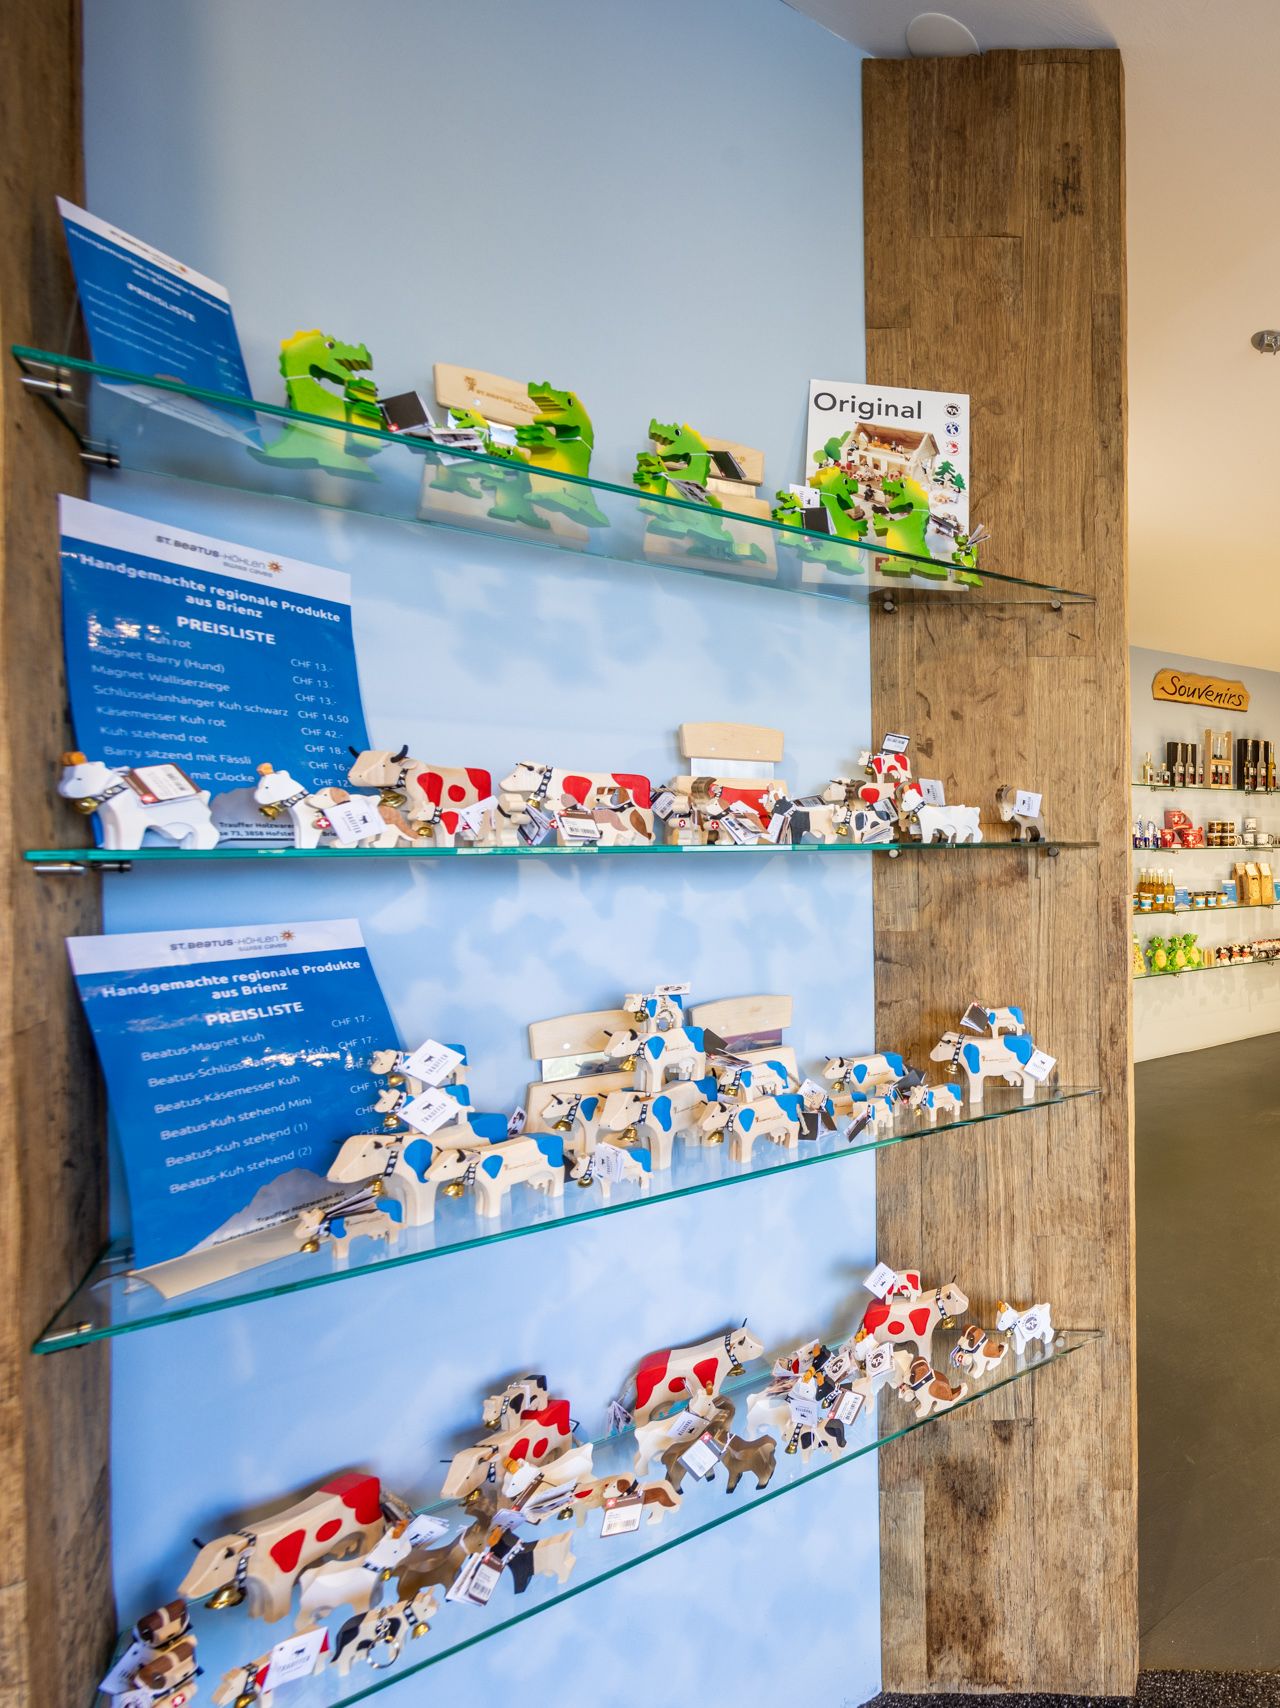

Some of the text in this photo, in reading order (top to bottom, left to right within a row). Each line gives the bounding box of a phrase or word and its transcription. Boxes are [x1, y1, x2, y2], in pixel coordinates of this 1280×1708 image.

[126, 282, 196, 323] PREISLISTE
[813, 392, 922, 420] Original
[80, 553, 341, 622] Handgemachte regionale Produkte
[185, 594, 263, 619] aus Brienz
[176, 615, 277, 645] PREISLISTE
[172, 637, 192, 650] rot
[146, 652, 181, 669] Barry
[184, 658, 225, 674] (Hund)
[290, 658, 311, 669] CHF
[90, 664, 230, 693] Magnet Walliserziege
[292, 675, 314, 686] CHF
[92, 684, 289, 717] Schlüsselanhänger Kuh schwarz
[294, 692, 316, 703] CHF
[1160, 676, 1245, 707] Souvenirs
[96, 705, 228, 728] Käsemesser Kuh rot
[297, 709, 350, 724] CHF 14.50
[100, 726, 209, 744] Kuh stehend rot
[300, 726, 322, 737] CHF
[103, 745, 253, 766] Barry sitzend mit Fässli
[304, 744, 326, 754] CHF
[308, 760, 330, 771] CHF
[189, 771, 256, 784] mit Glocke
[312, 777, 333, 787] CHF
[219, 821, 253, 830] Trauffer
[101, 961, 361, 998] Handgemachte regionale Produkte
[211, 982, 289, 1000] aus Brienz
[204, 1001, 305, 1026] PREISLISTE
[331, 1017, 351, 1028] CHF
[141, 1032, 266, 1062] Beatus-Magnet Kuh
[307, 1045, 329, 1056] Kuh
[337, 1038, 358, 1050] CHF
[344, 1060, 366, 1072] CHF
[153, 1074, 301, 1114] Beatus-Käsemesser Kuh
[350, 1082, 370, 1094] CHF
[160, 1096, 313, 1140] Beatus-Kuh stehend Mini
[355, 1104, 375, 1116] CHF
[164, 1121, 308, 1168] Beatus-Kuh stehend (1)
[170, 1145, 313, 1194] Beatus-Kuh stehend (2)
[257, 1210, 291, 1222] Trauffer
